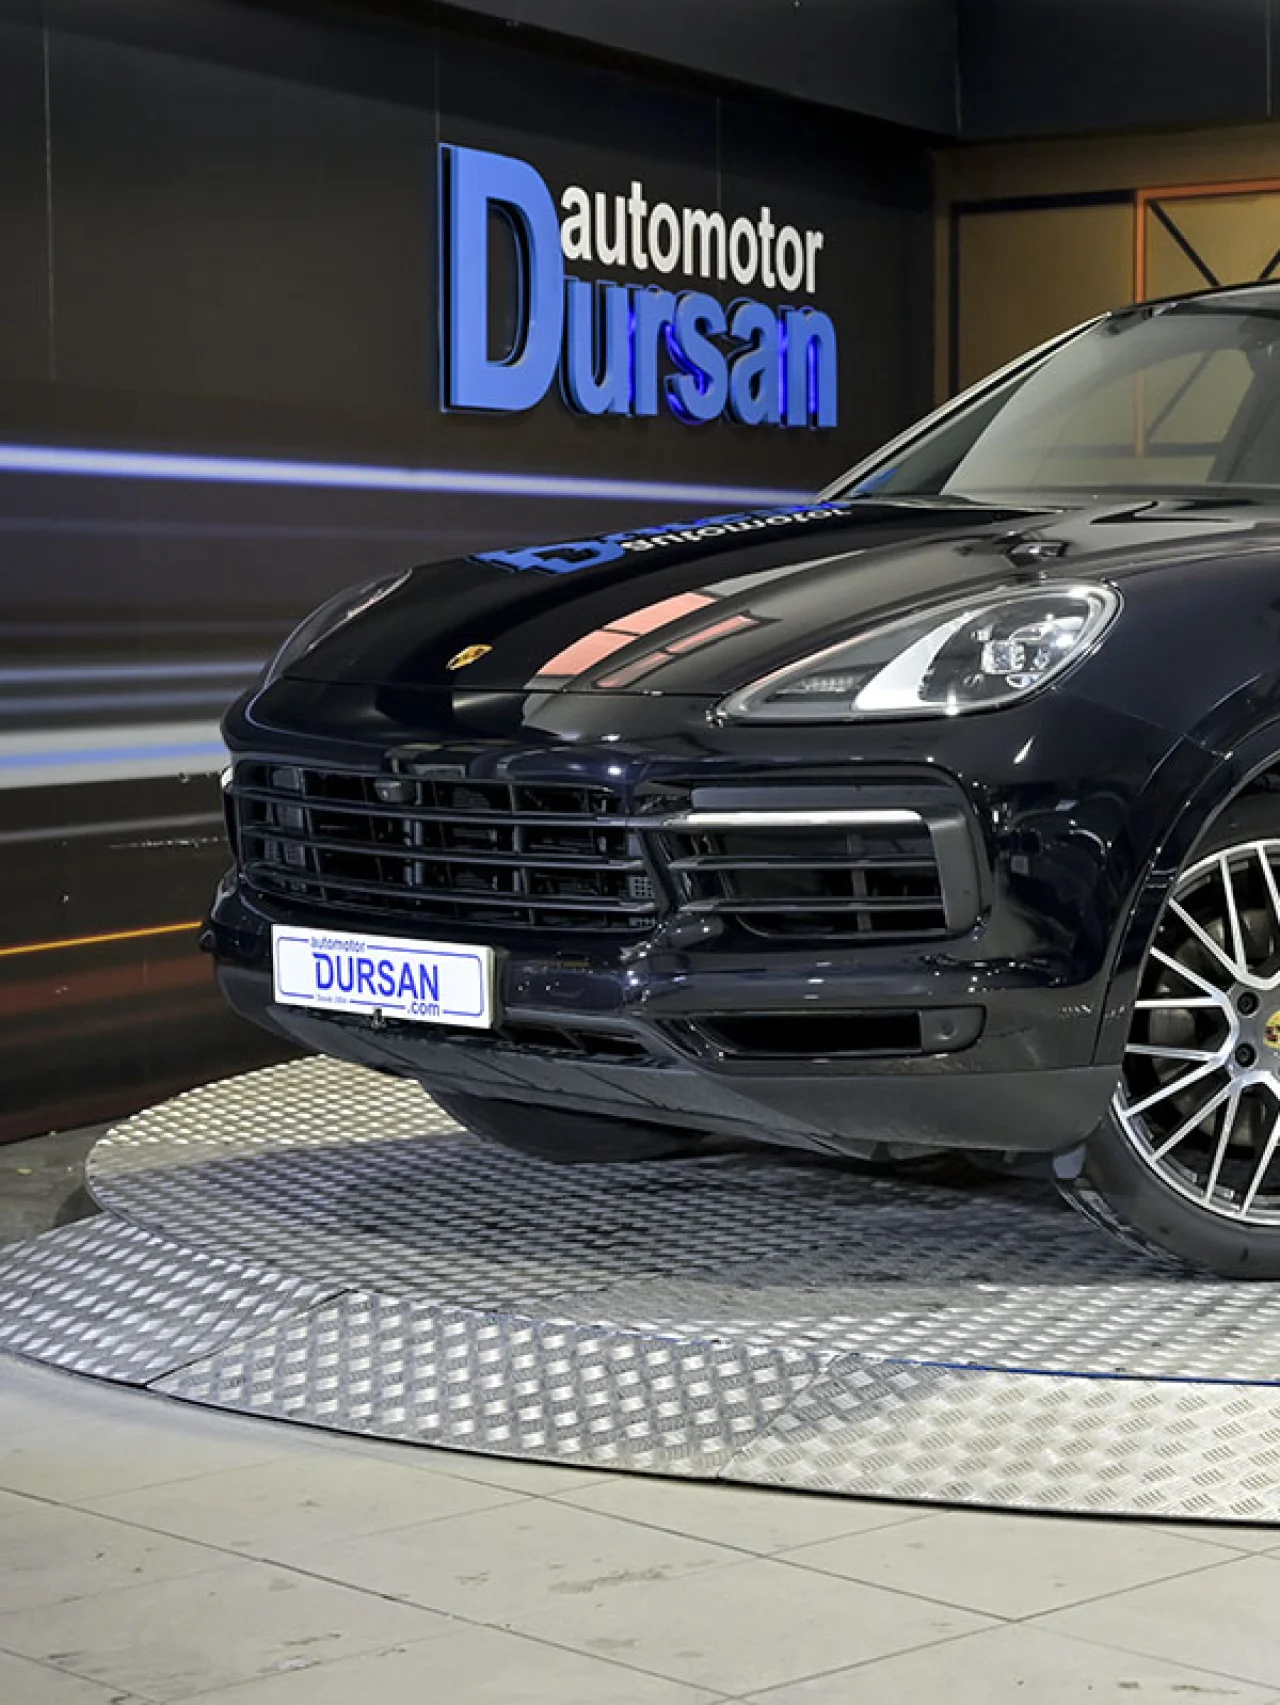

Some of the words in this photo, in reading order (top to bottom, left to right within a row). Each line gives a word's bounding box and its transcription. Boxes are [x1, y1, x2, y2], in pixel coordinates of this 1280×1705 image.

[560, 181, 824, 293] automotor
[440, 142, 838, 430] Dursan
[310, 937, 366, 952] automotor
[312, 953, 440, 1001] DURSAN
[408, 1001, 441, 1016] .com
